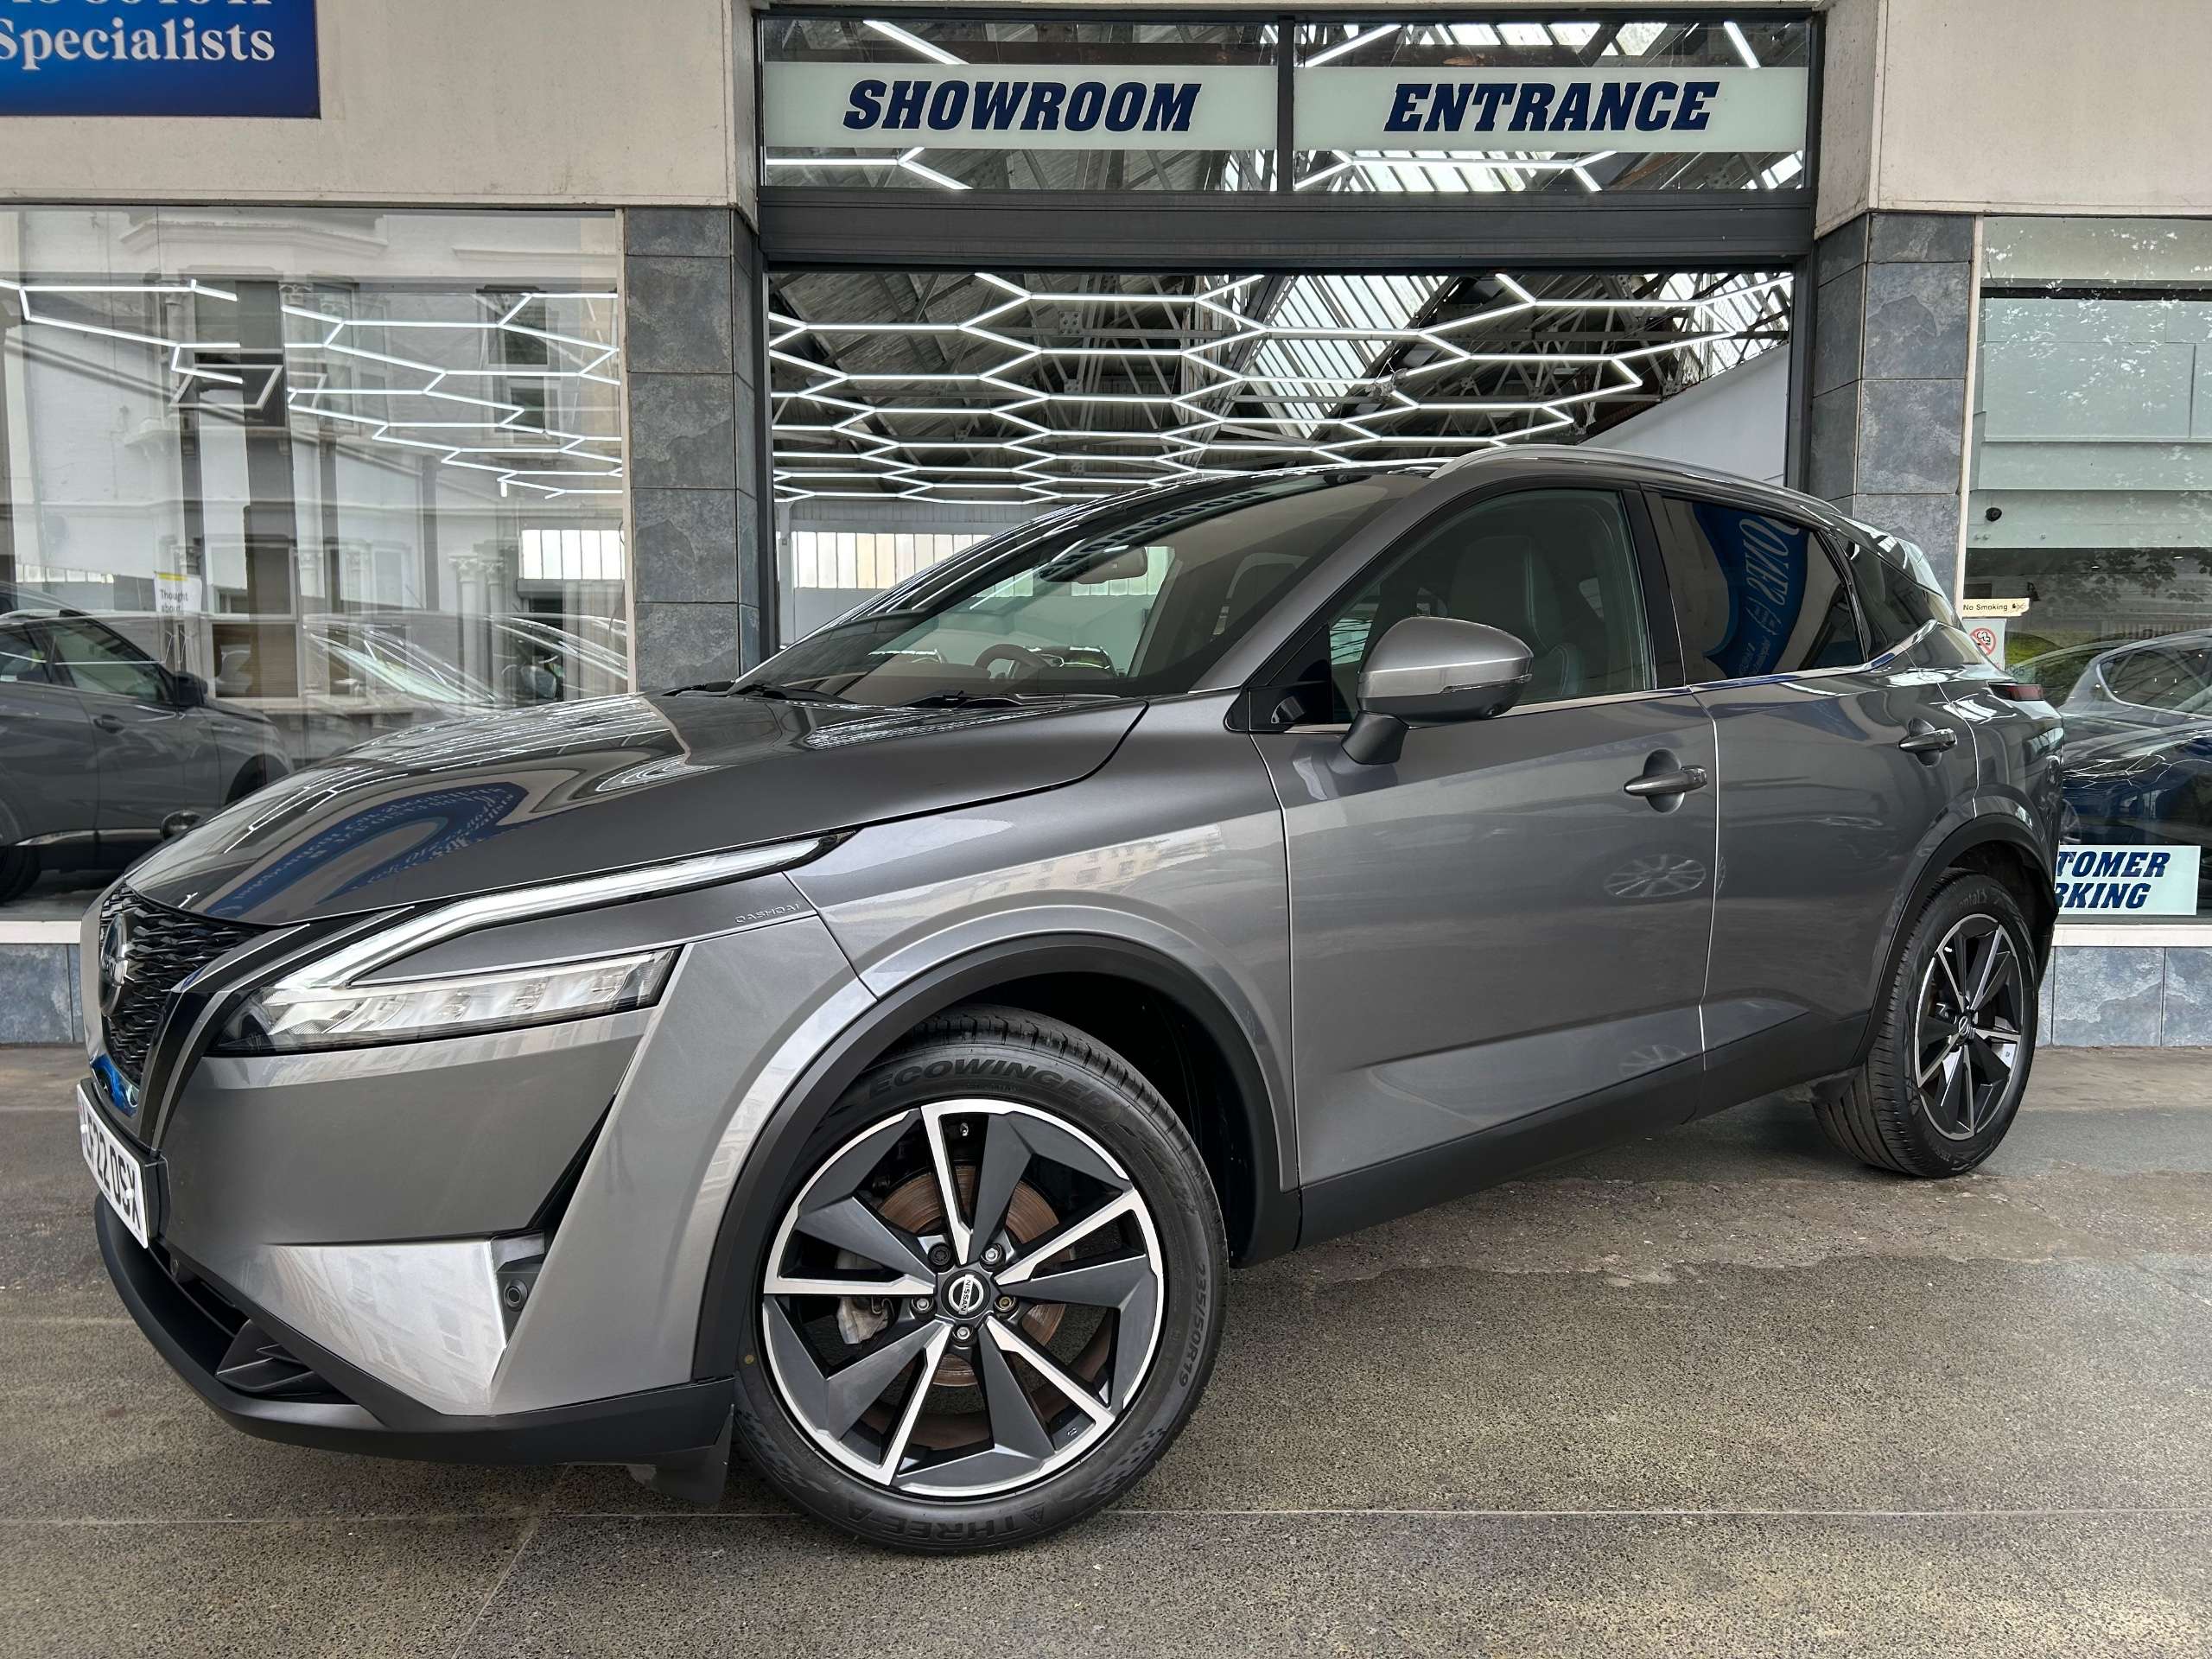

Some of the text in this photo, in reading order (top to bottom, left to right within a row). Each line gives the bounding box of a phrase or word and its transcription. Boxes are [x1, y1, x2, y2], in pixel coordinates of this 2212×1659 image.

[0, 17, 275, 70] Specialists
[842, 79, 1719, 132] SHOWROOM ENTRANCE
[160, 588, 189, 603] Thought
[1976, 603, 2008, 612] Smoking
[959, 1279, 973, 1313] NISSAN
